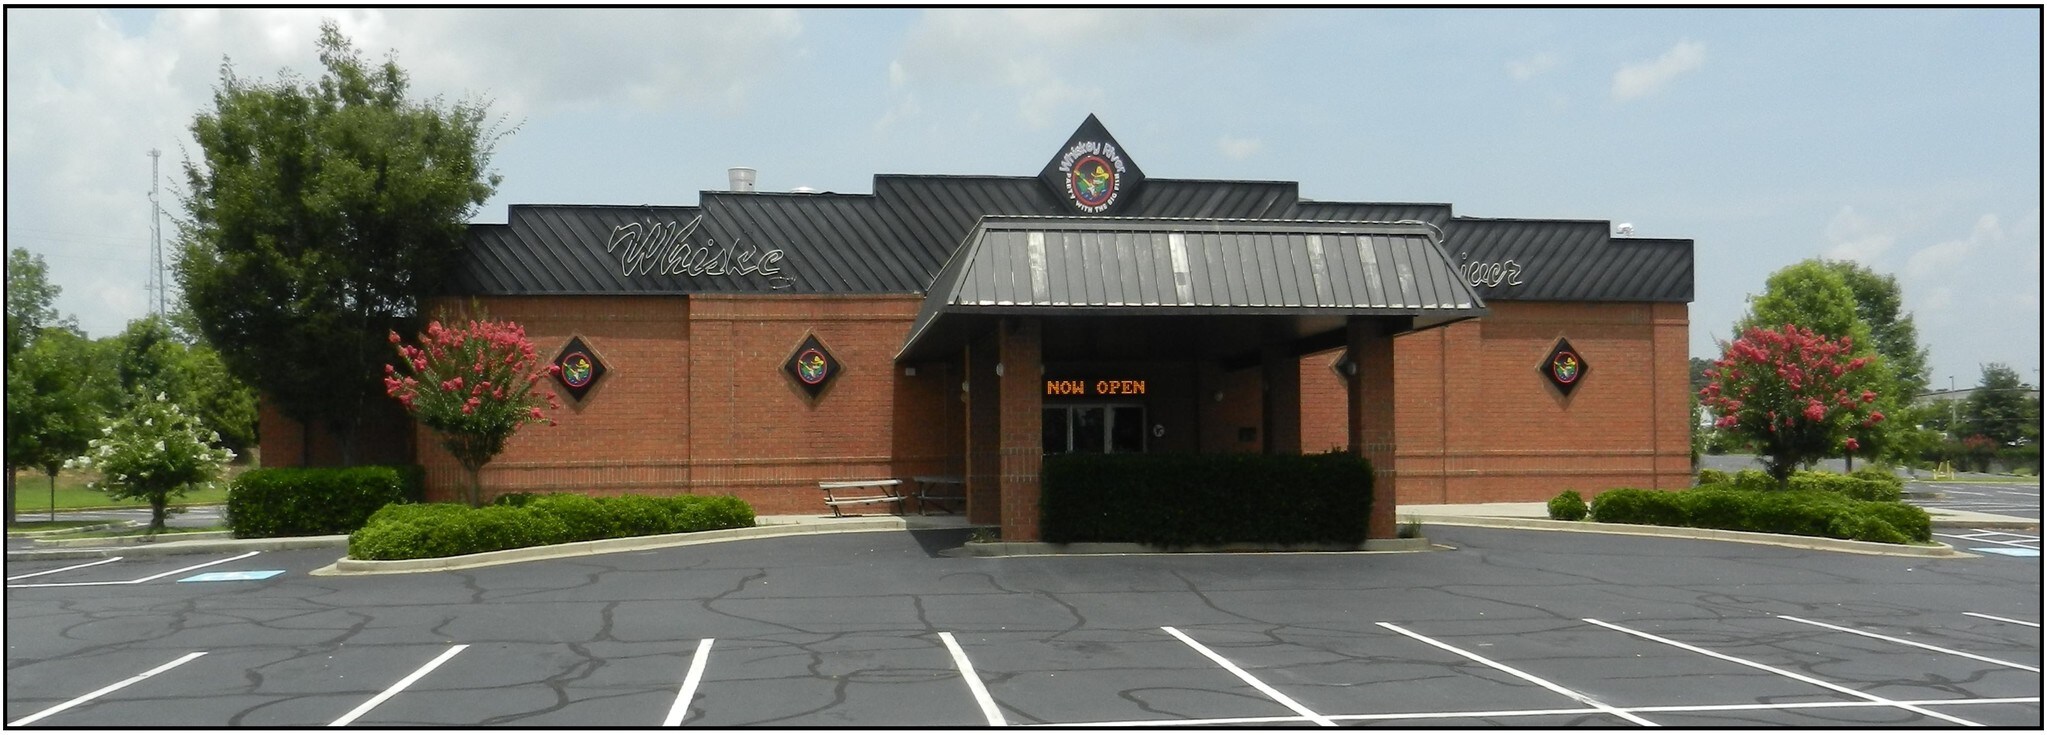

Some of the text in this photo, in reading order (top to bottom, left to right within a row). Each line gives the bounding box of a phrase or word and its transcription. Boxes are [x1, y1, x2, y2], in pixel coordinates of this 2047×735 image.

[1059, 141, 1126, 174] Whiskey River
[1065, 173, 1075, 199] PARTY
[1076, 200, 1093, 213] WITH
[1095, 203, 1107, 213] THE
[1108, 193, 1118, 205] BIG
[1047, 380, 1146, 394] NOW OPEN
